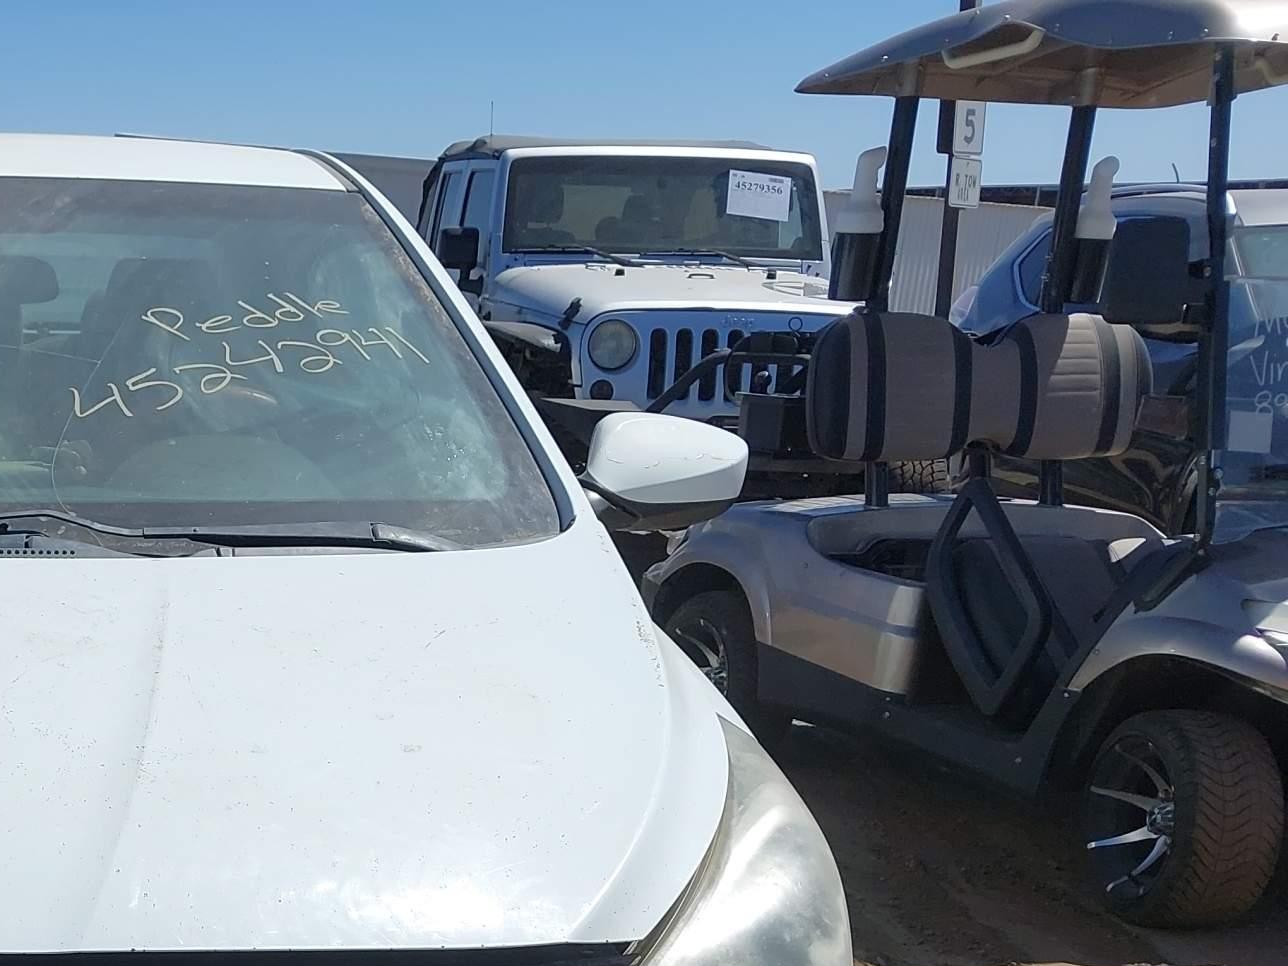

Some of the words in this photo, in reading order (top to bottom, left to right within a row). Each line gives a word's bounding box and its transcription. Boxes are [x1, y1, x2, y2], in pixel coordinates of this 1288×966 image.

[963, 108, 976, 144] 5
[734, 180, 784, 195] 45279356
[141, 292, 349, 340] Peddle
[68, 326, 430, 417] 45242941
